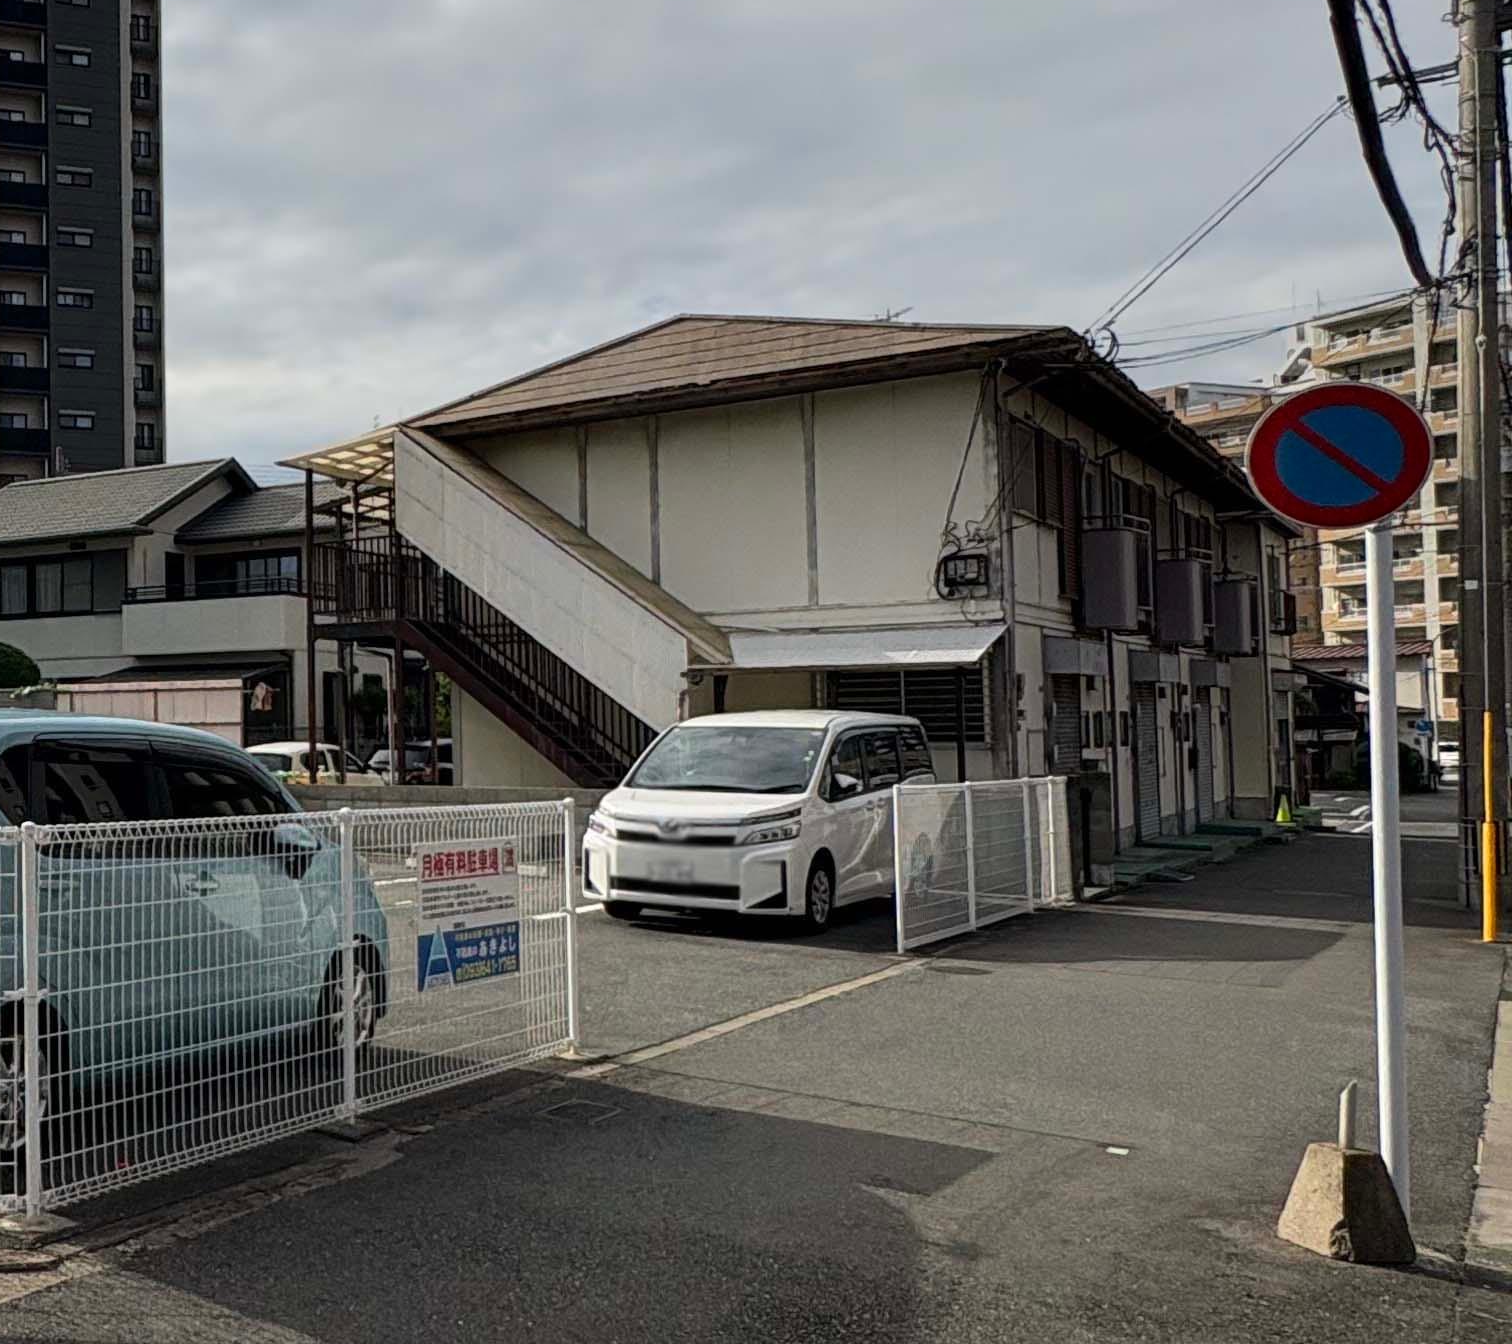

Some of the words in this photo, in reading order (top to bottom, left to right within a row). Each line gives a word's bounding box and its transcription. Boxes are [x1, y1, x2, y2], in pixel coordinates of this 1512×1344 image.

[422, 847, 498, 878] 月極有料駐車場
